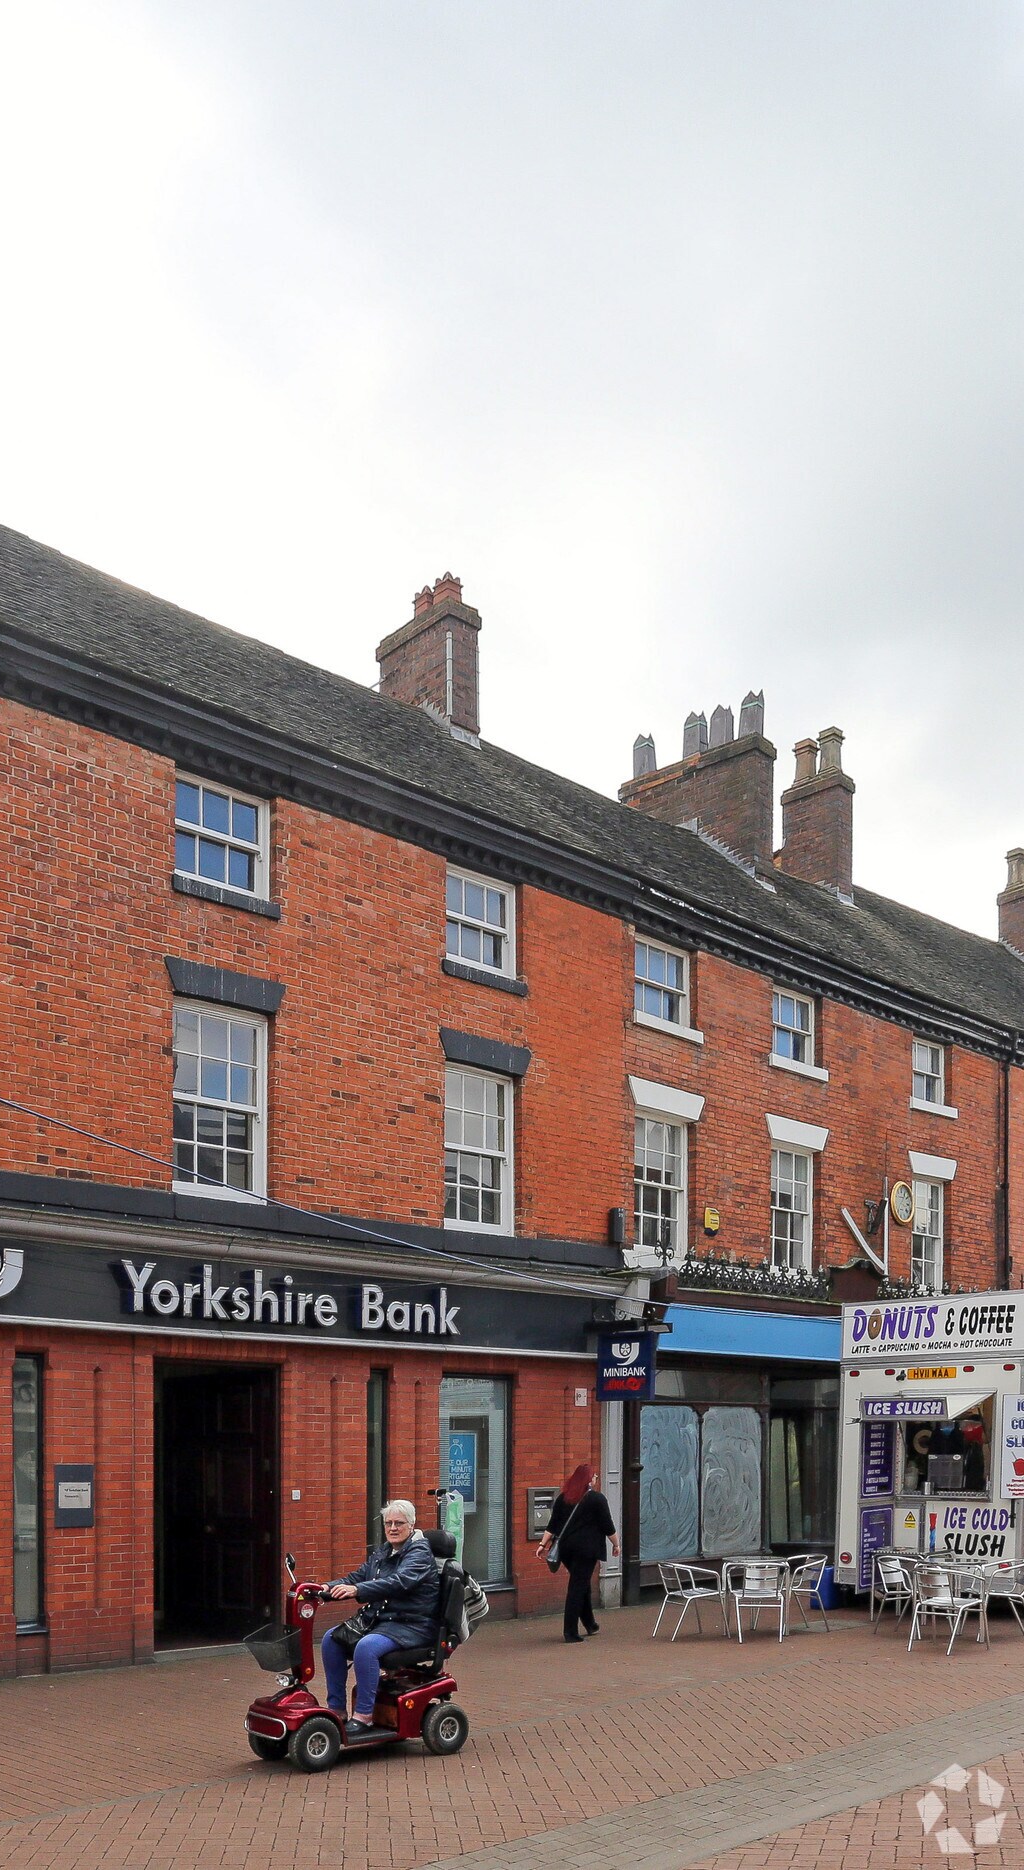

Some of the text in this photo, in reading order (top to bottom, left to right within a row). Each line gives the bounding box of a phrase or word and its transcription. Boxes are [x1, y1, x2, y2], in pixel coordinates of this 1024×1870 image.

[121, 1259, 460, 1335] Yorkshire Bank
[853, 1305, 1016, 1342] DONUTS & COFFEE
[851, 1338, 1013, 1354] LATTE CAPPUCCINO MOCHA HOT CHOCOLATE
[603, 1367, 646, 1377] MINIBANK
[868, 1402, 942, 1415] ICE SLUSH
[944, 1507, 1009, 1531] ICE COLD
[944, 1533, 1006, 1557] SLUSH
